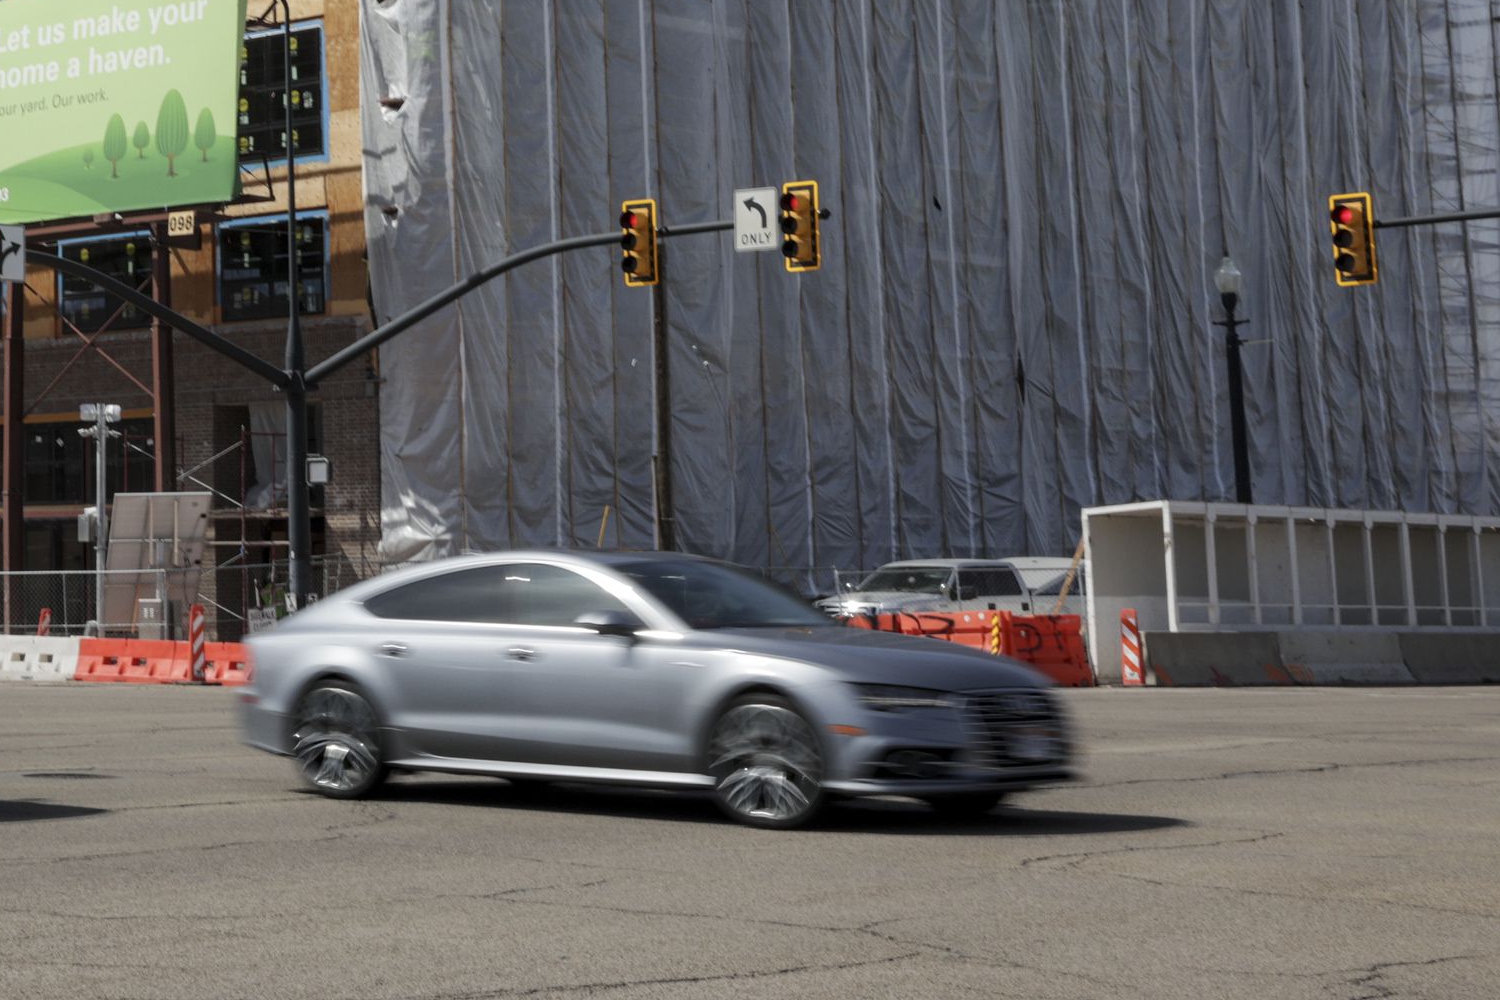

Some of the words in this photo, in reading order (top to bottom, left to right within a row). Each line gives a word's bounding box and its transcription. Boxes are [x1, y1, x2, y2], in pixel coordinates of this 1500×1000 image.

[37, 21, 66, 46] us
[73, 6, 140, 40] make
[67, 56, 81, 79] a
[88, 42, 172, 75] haven.
[19, 96, 49, 117] yard.
[51, 93, 73, 110] Our
[76, 88, 110, 106] work.
[170, 214, 193, 232] 098
[741, 231, 773, 246] ONLY
